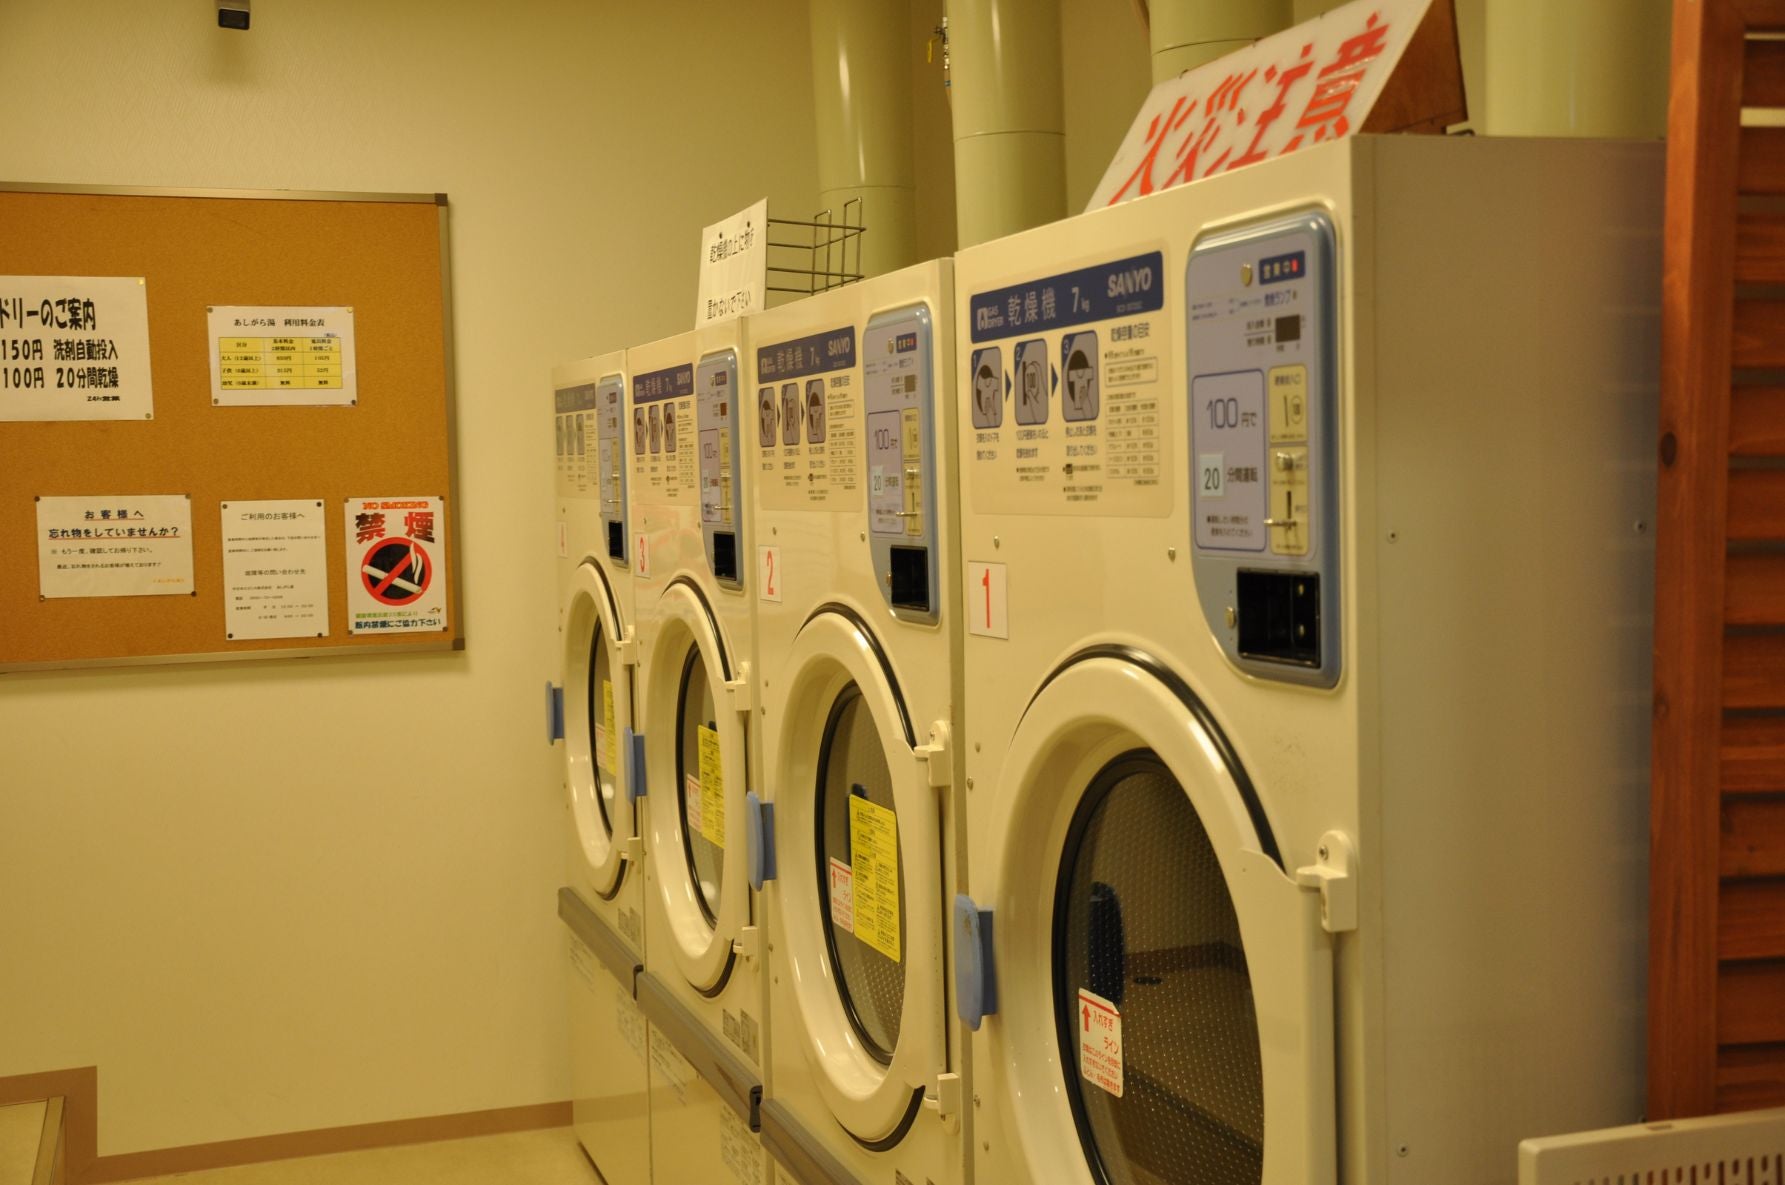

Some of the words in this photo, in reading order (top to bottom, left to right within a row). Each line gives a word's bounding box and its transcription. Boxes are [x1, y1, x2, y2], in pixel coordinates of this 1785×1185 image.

[1107, 266, 1152, 298] SANYO
[1008, 287, 1056, 327] 乾燥機
[234, 318, 275, 327] あしがら湯
[284, 318, 325, 327] 利用料金表
[2, 339, 43, 360] 150円
[53, 339, 119, 360] 洗剤自動投入
[3, 367, 45, 389] 100円
[56, 367, 119, 388] 20分間乾燥
[1204, 467, 1220, 491] 20
[766, 551, 774, 595] 2
[983, 569, 991, 629] 1
